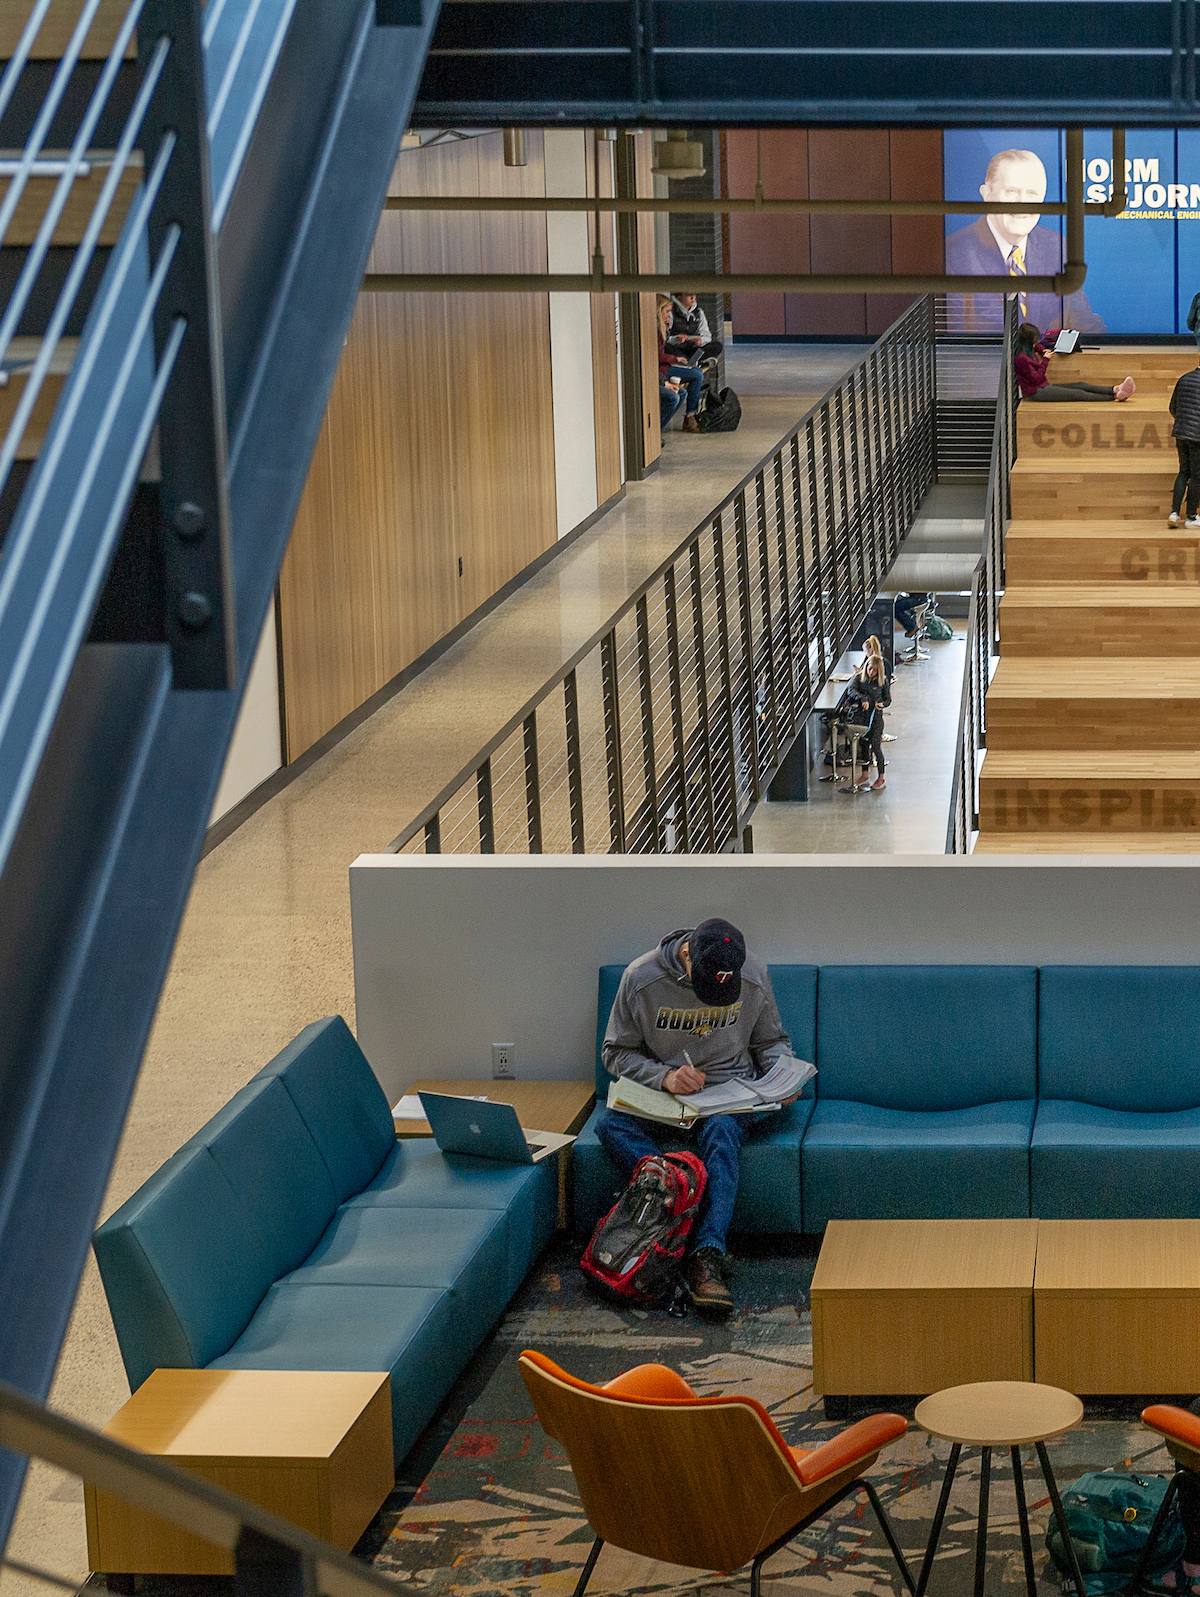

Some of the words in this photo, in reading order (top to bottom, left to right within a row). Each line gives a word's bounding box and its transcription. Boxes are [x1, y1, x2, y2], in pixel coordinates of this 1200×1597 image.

[1066, 158, 1159, 183] OM
[1115, 211, 1175, 219] MECHANICAL
[655, 1001, 743, 1030] BOBCATS
